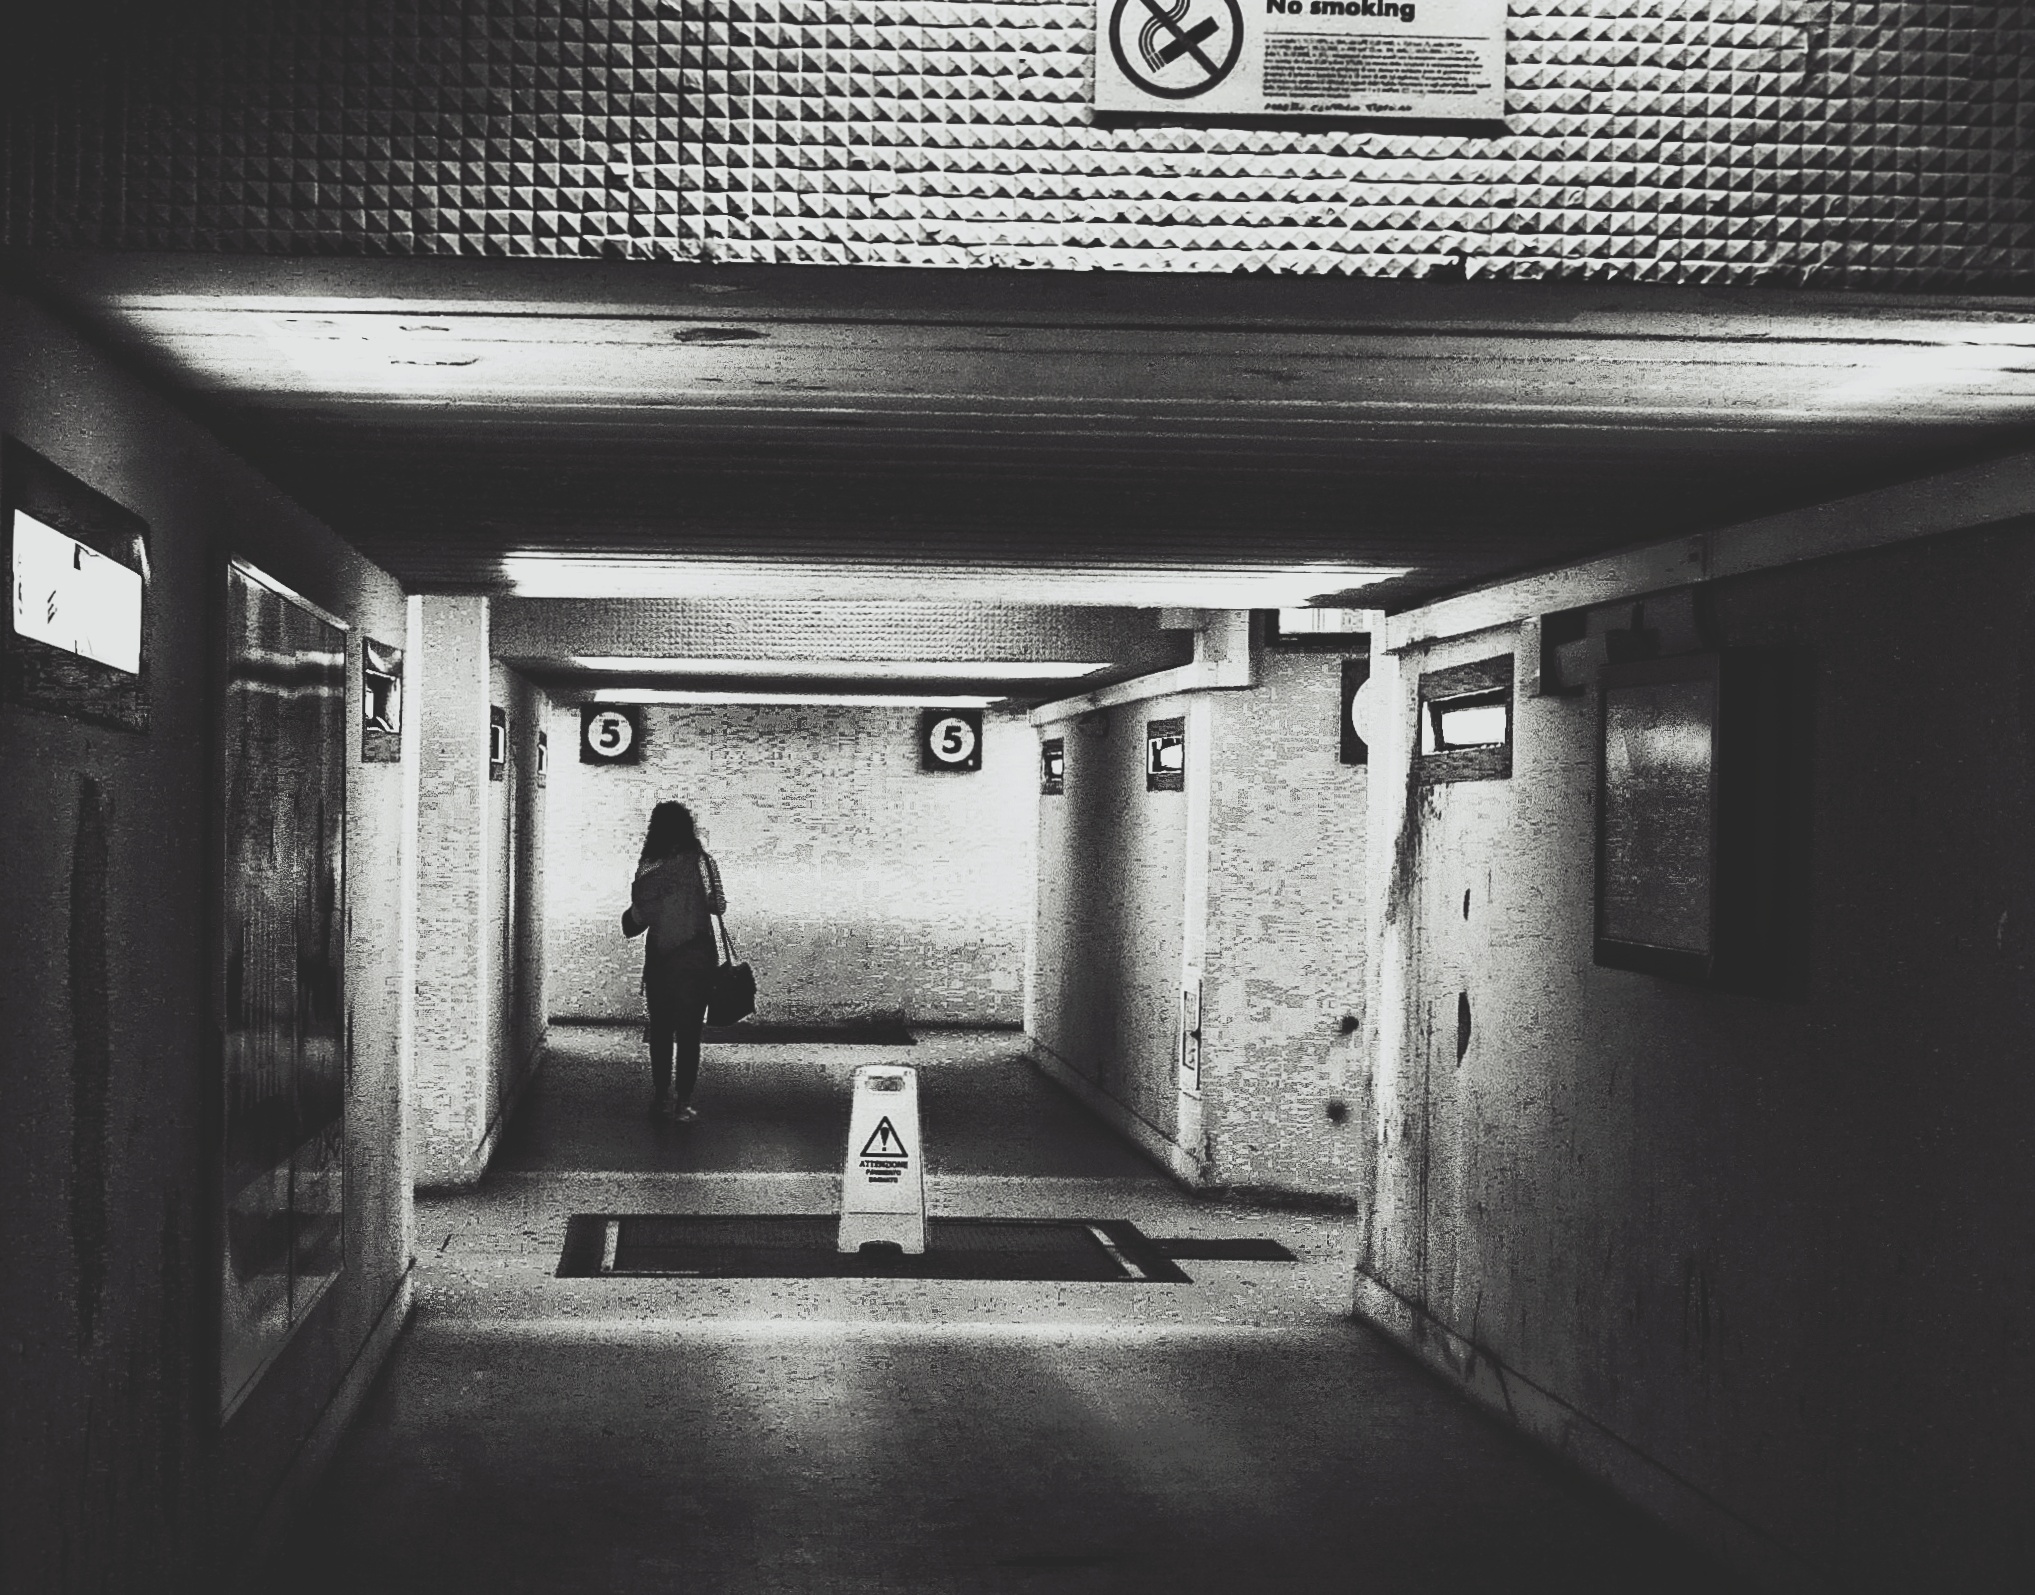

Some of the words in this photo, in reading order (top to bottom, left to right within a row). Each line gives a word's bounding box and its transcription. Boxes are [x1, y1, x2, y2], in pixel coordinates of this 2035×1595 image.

[1266, 0, 1302, 14] No
[1310, 0, 1415, 22] smoking
[599, 718, 621, 749] 5
[941, 725, 963, 755] 5
